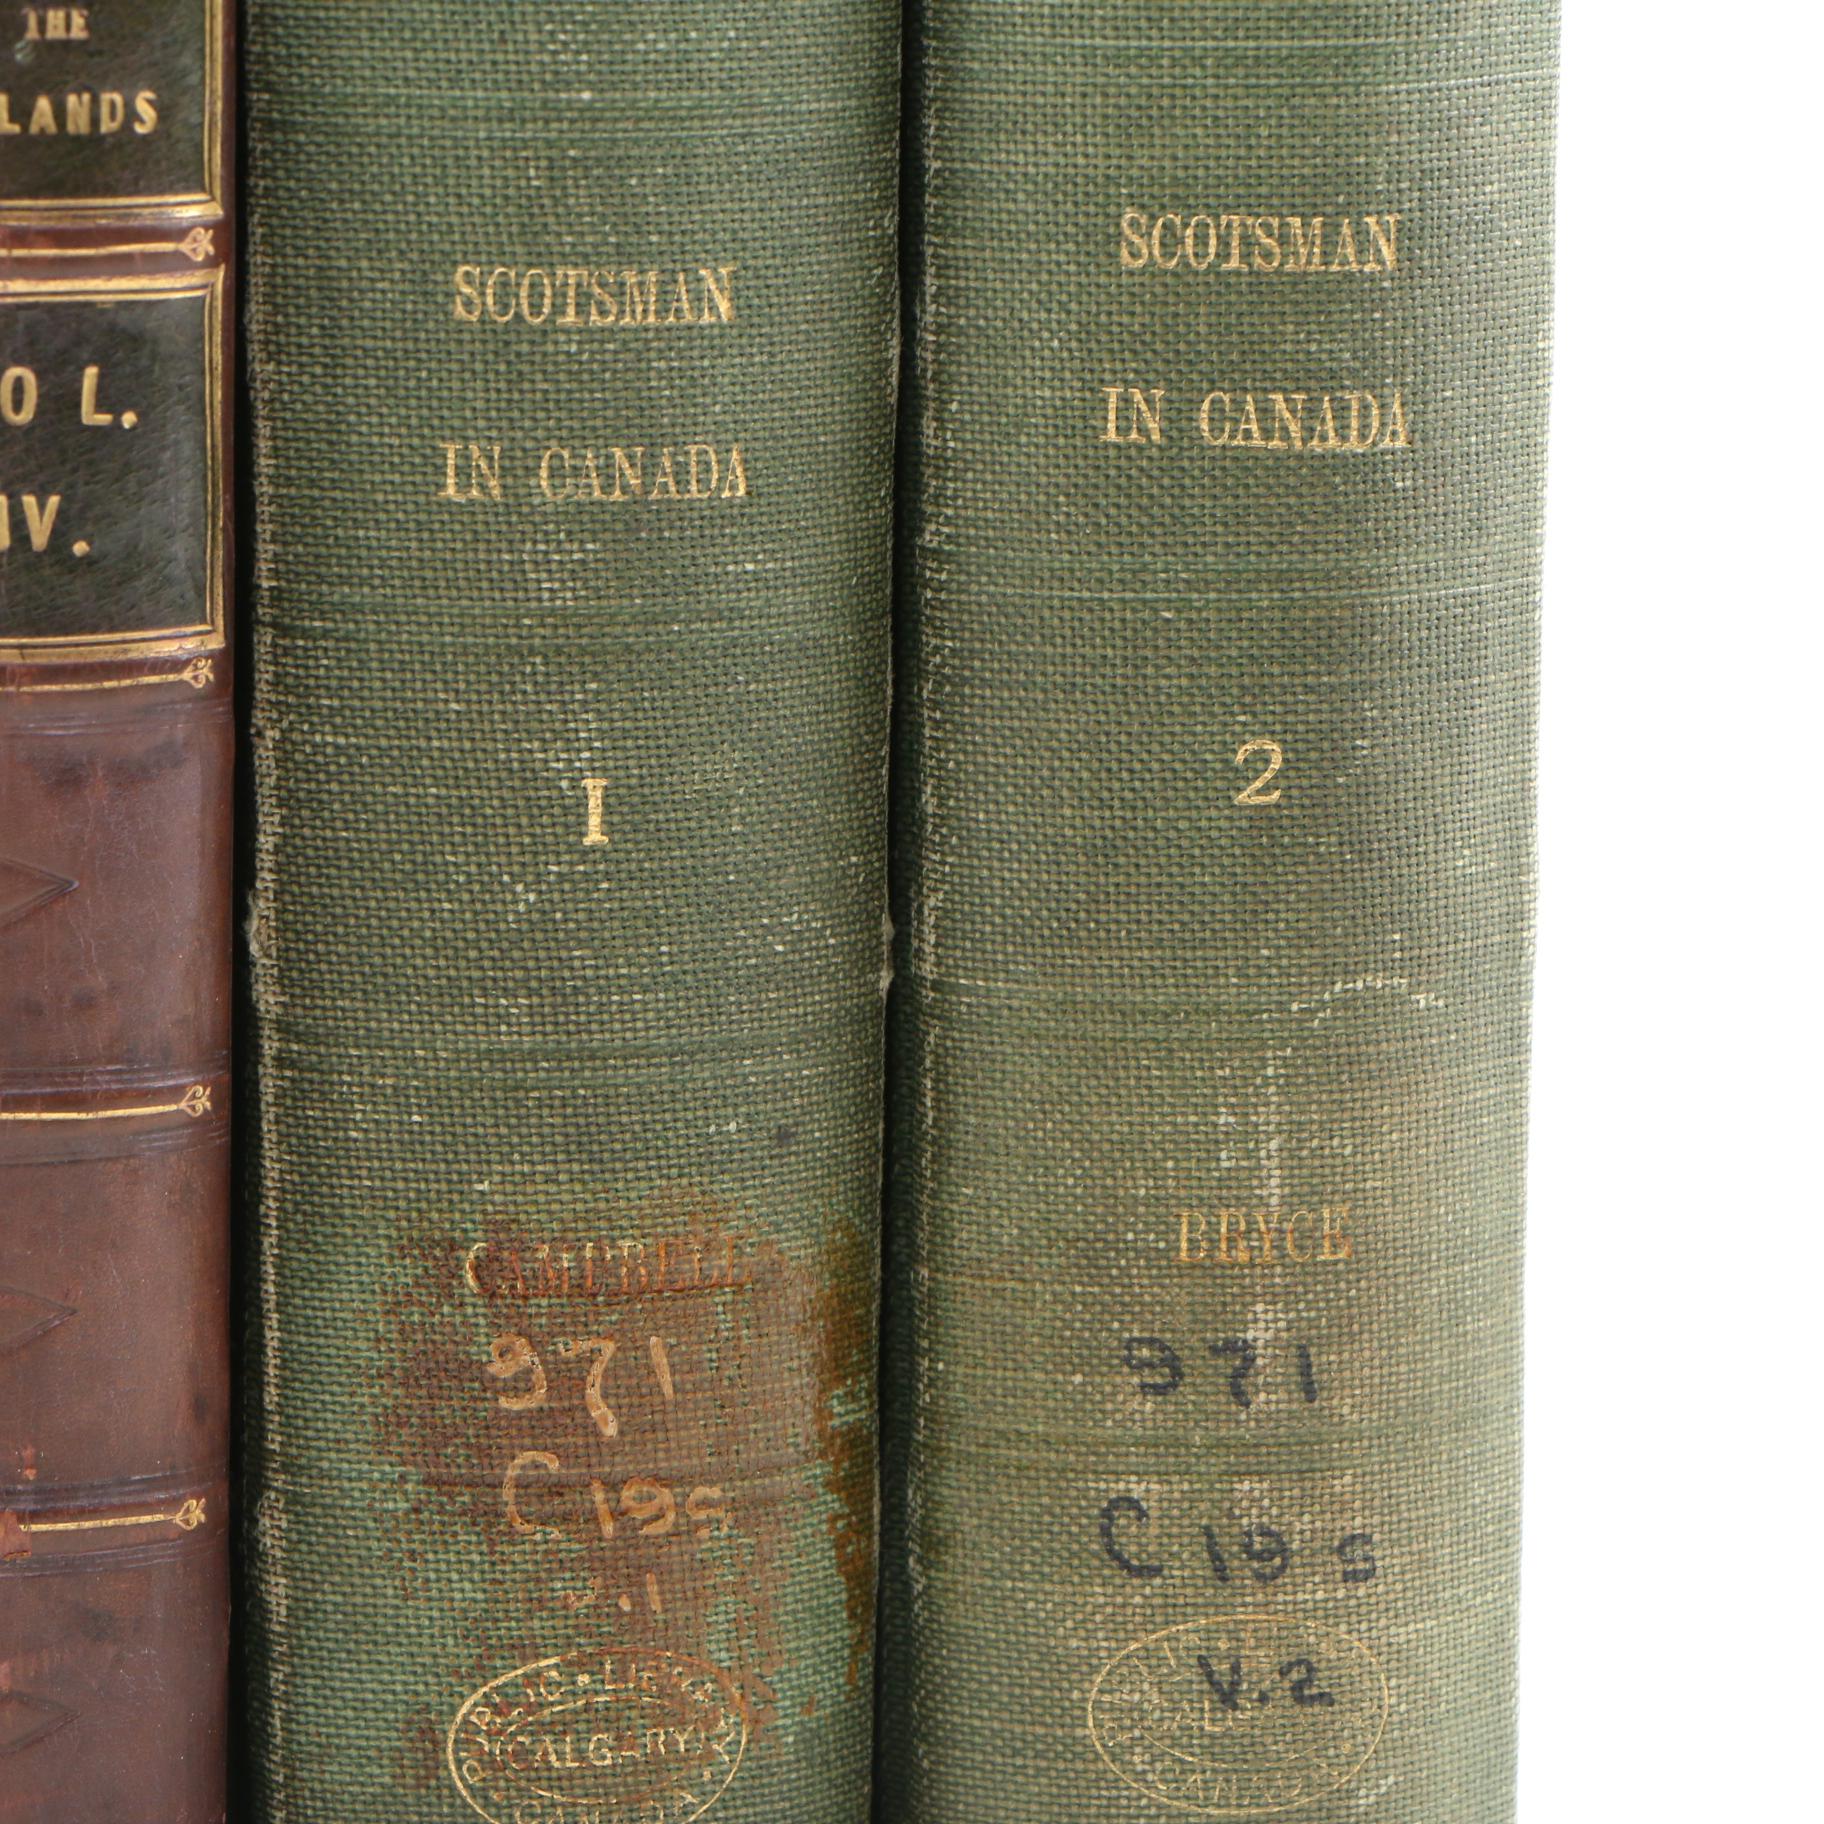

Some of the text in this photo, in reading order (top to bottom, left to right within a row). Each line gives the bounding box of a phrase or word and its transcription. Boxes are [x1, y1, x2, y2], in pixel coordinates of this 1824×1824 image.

[21, 8, 90, 40] THE
[0, 90, 158, 135] LANDS
[1119, 212, 1401, 272] SCOTSMAN
[453, 264, 738, 326] SCOTSMAN
[1099, 386, 1413, 450] IN CANADA
[437, 443, 751, 502] IN CANADA
[1233, 739, 1282, 806] 2
[1173, 1207, 1352, 1264] BRYCE
[486, 1332, 674, 1438] 971
[1122, 1337, 1318, 1408] 971
